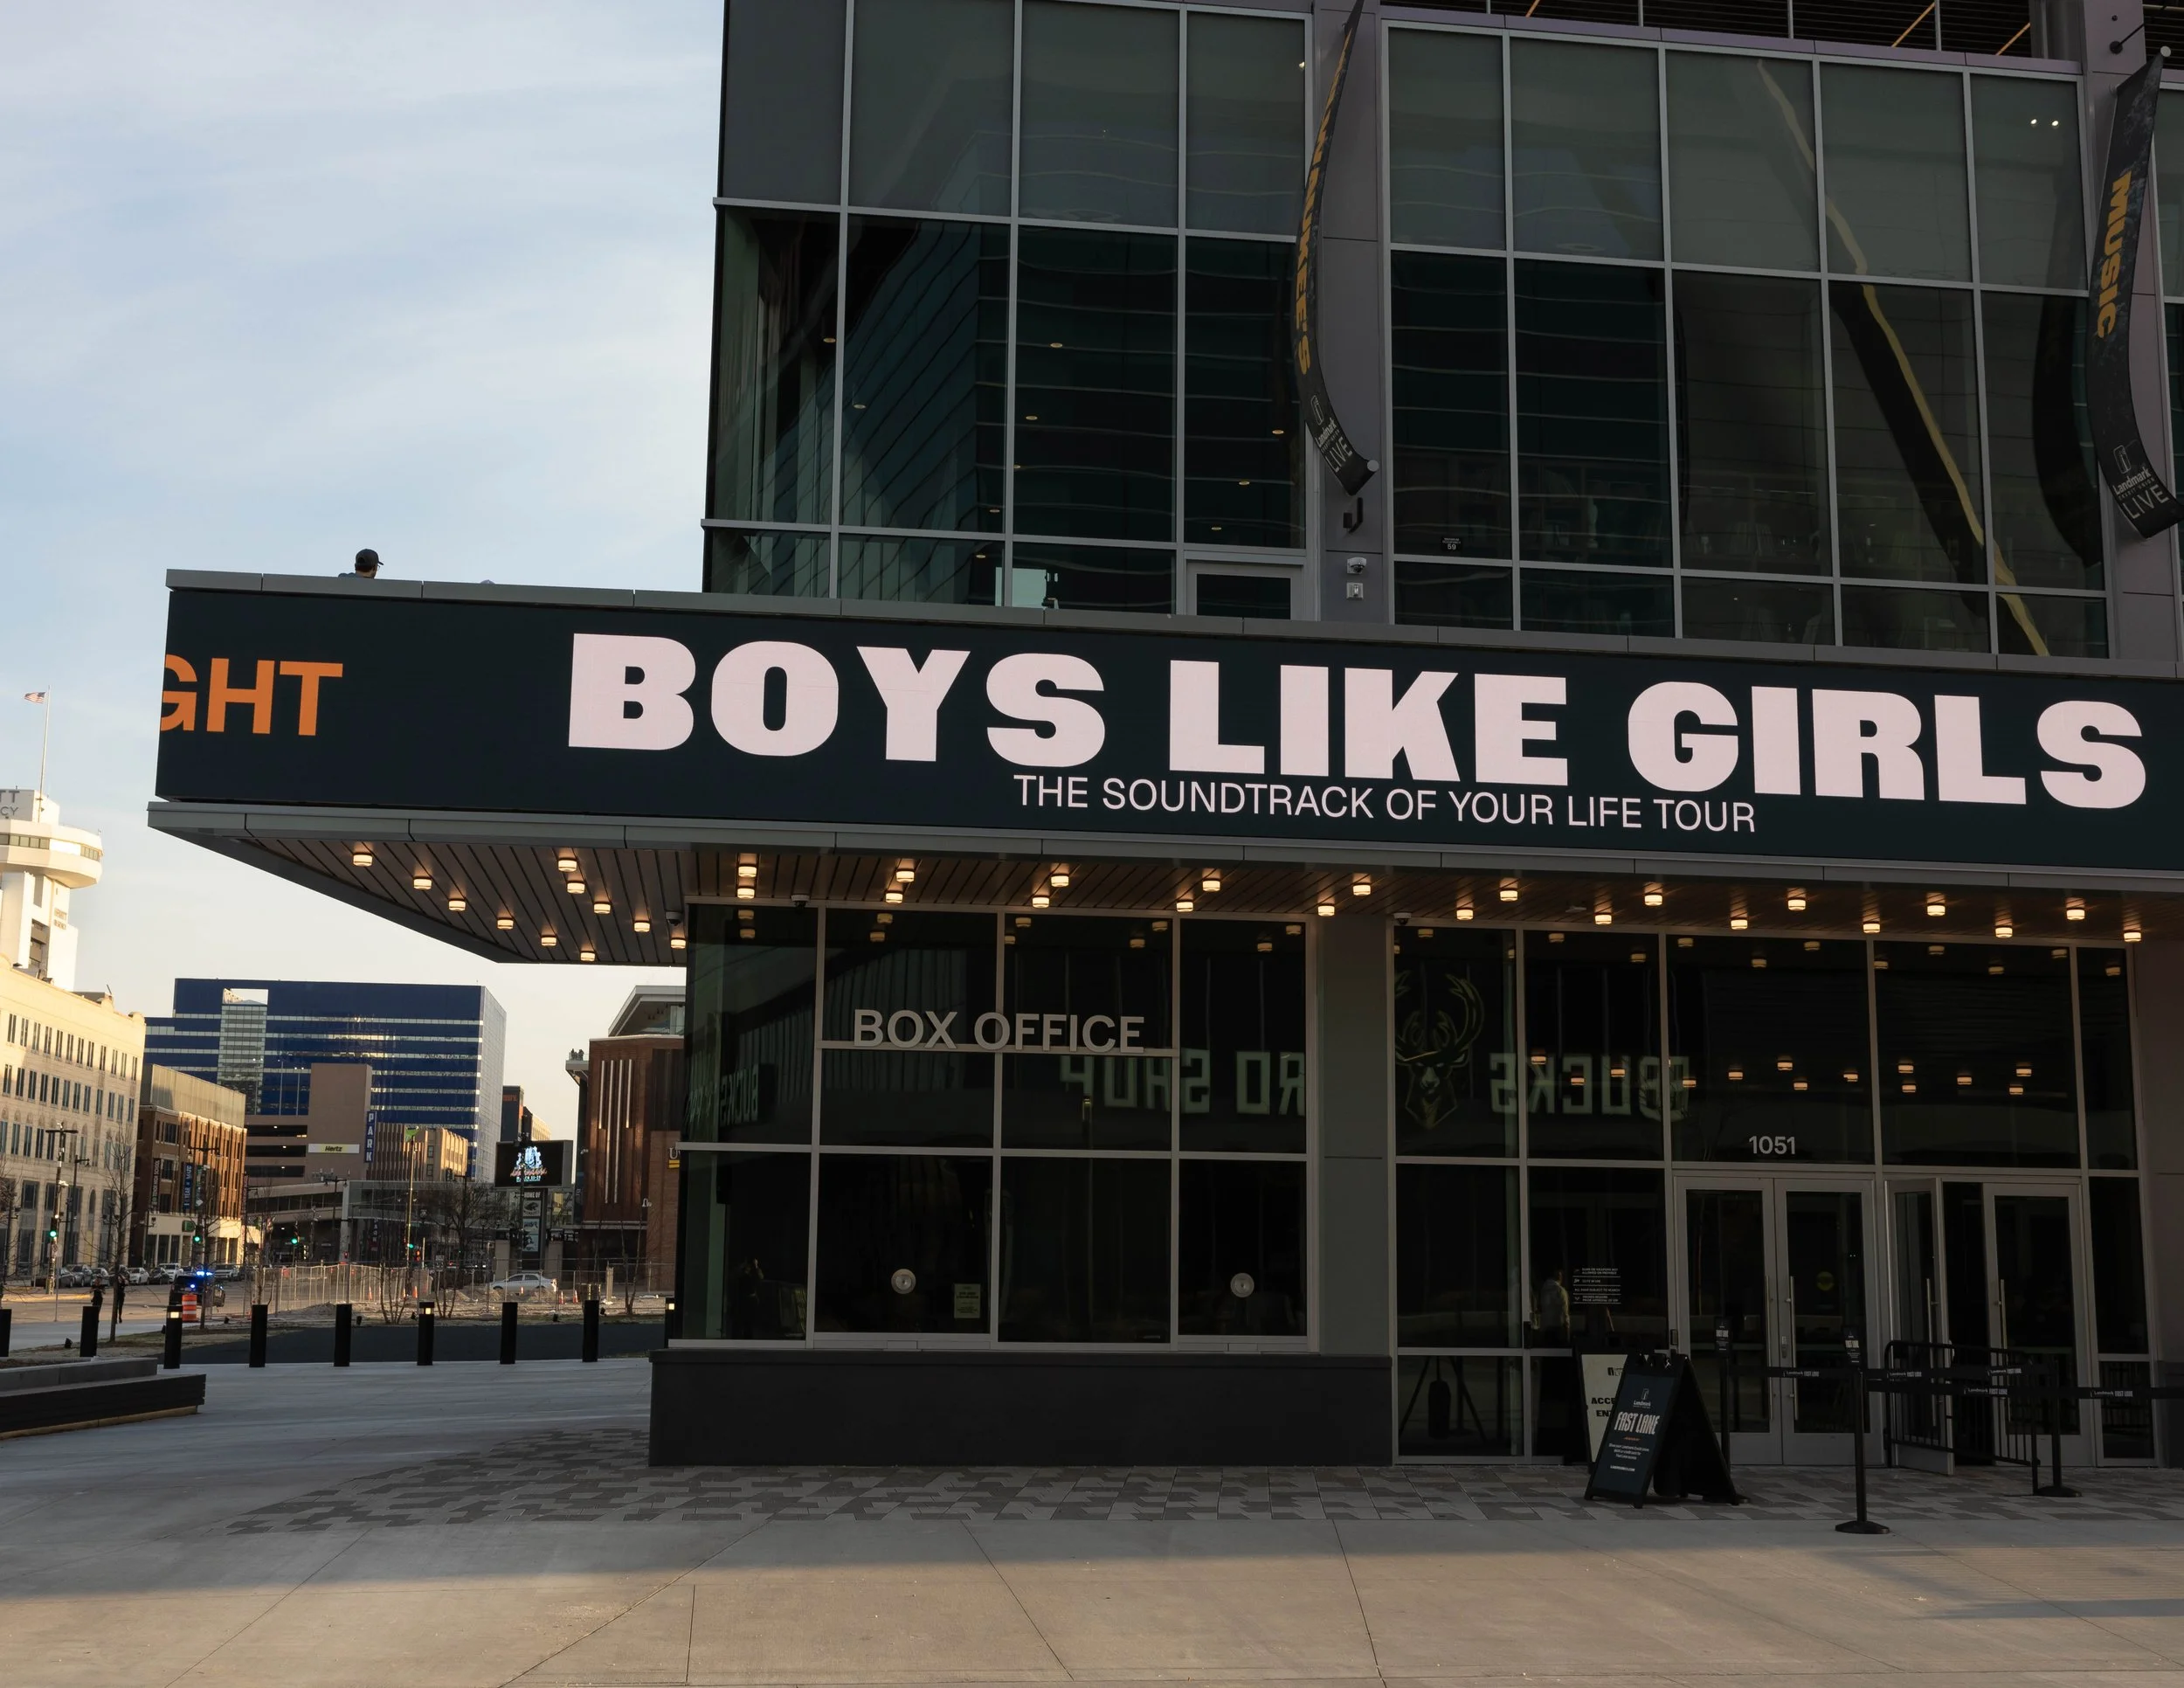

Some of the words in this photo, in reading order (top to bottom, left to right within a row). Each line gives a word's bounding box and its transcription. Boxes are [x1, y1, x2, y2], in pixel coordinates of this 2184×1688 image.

[2098, 170, 2132, 338] MUSIC
[1315, 417, 1337, 447] Landmark
[1325, 436, 1352, 473] LIVE
[2112, 467, 2151, 495] Landmark
[2122, 484, 2169, 519] LIVE
[569, 633, 1105, 768] BOYS
[1170, 660, 1568, 786] LIKE
[1628, 681, 2146, 809] GIRLS
[1014, 774, 1089, 811] THE
[1102, 778, 1374, 819] SOUNDTRACK
[1386, 789, 1437, 820] OF
[1448, 791, 1553, 825] YOUR
[1569, 796, 1641, 828] LIFE
[1653, 799, 1755, 833] TOUR
[854, 1009, 958, 1049] BOX
[974, 1012, 1144, 1053] OFFICE
[366, 1112, 375, 1161] PARK
[1749, 1135, 1795, 1155] 1051
[1614, 1411, 1639, 1432] FAST
[1635, 1414, 1660, 1435] LANE
